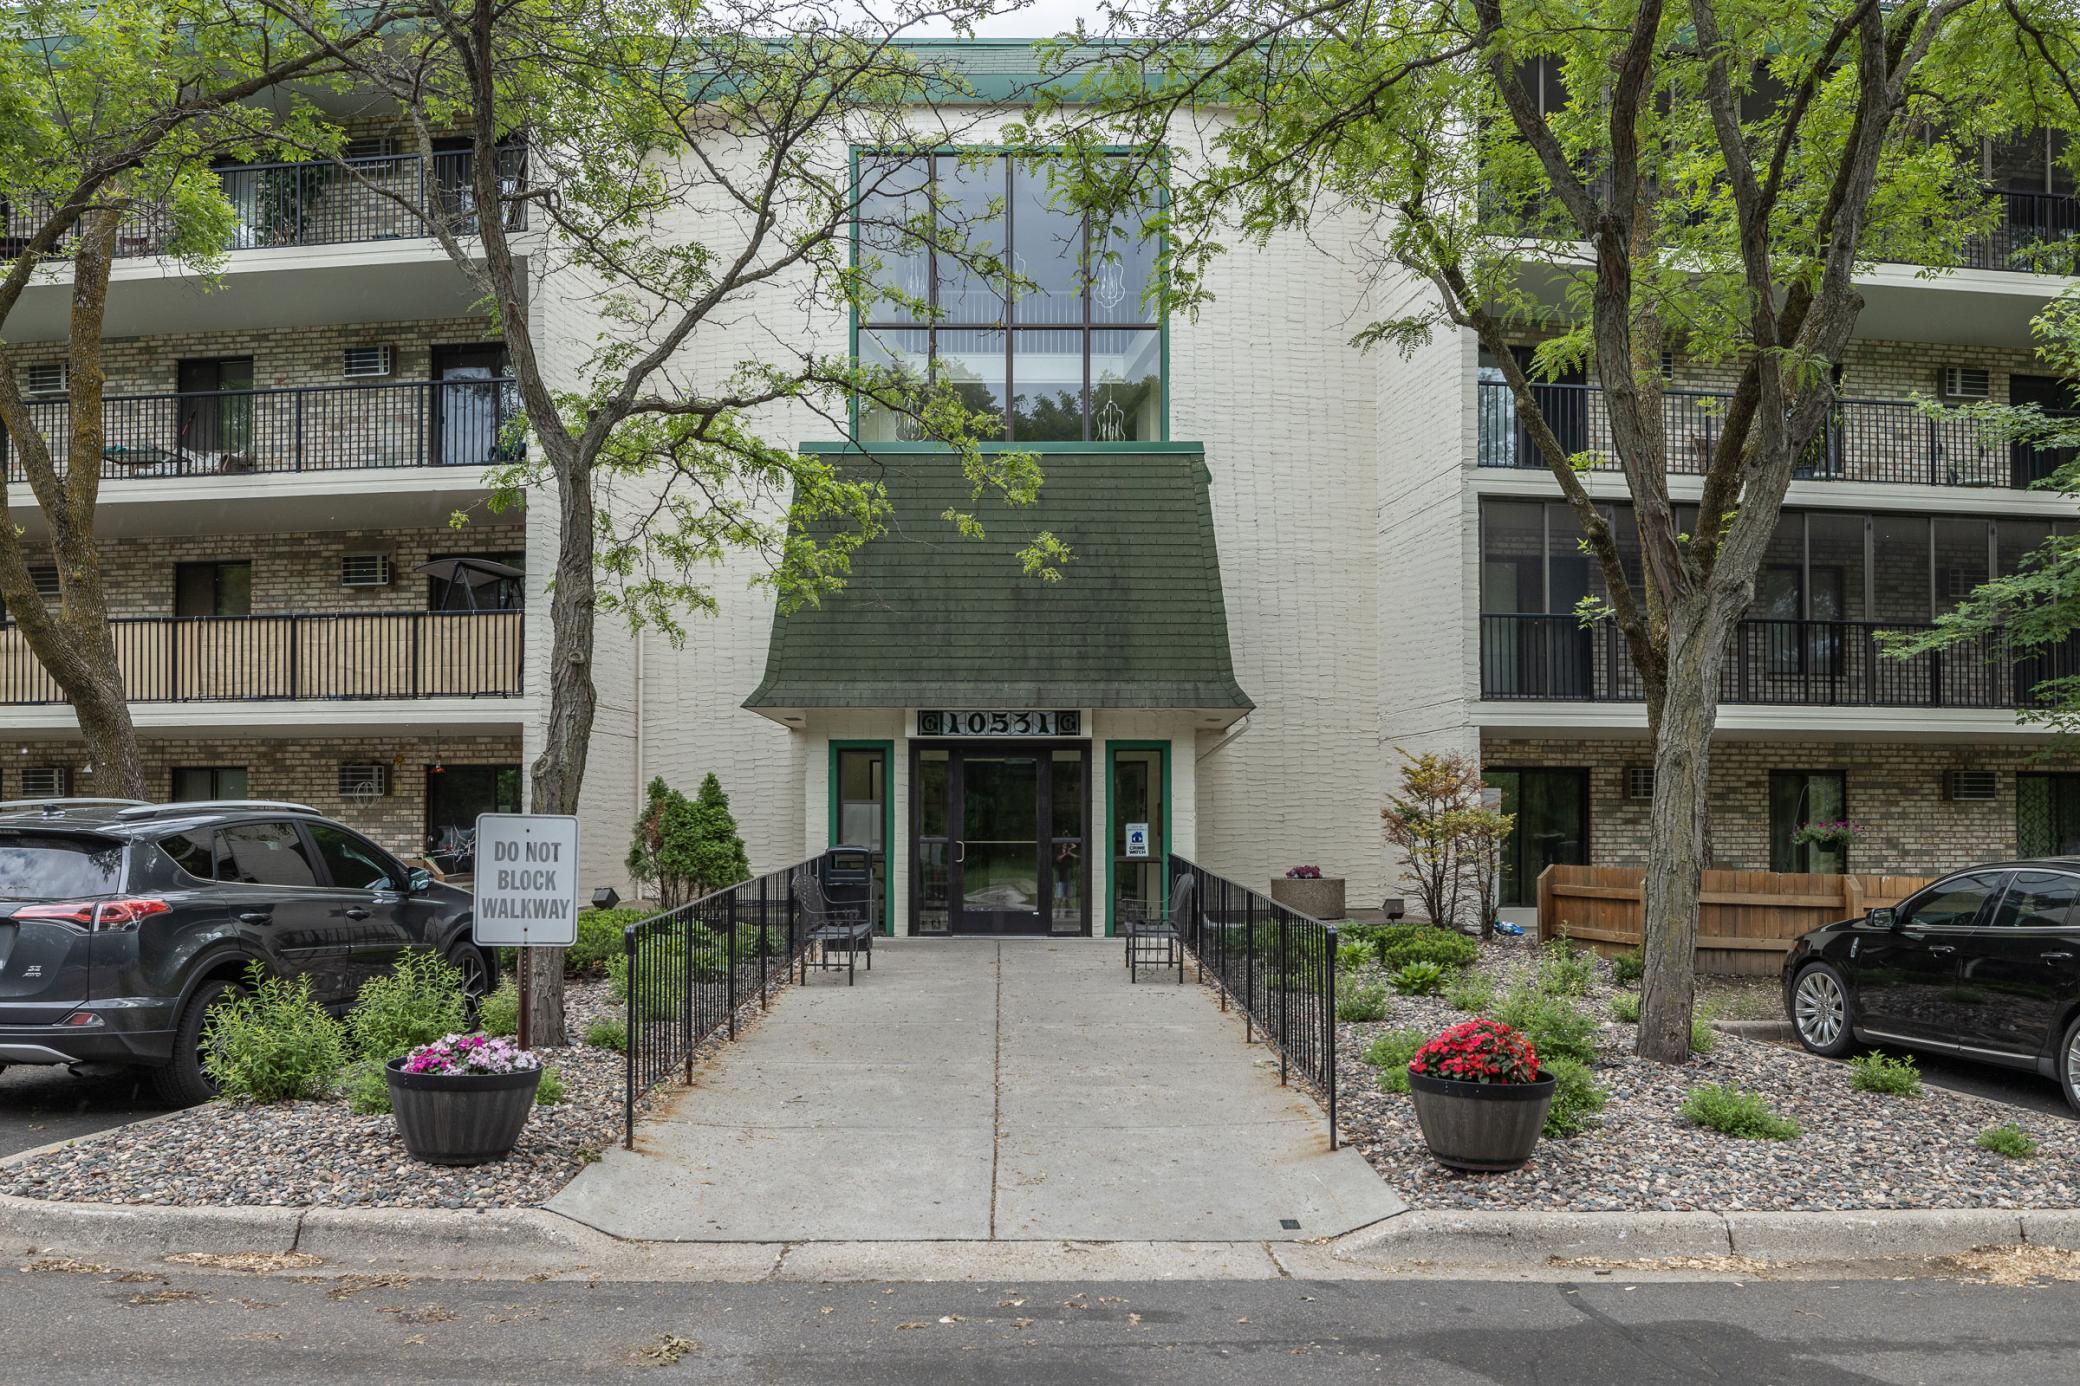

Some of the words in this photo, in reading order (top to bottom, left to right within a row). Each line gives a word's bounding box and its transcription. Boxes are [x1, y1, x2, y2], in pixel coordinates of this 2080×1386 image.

[948, 712, 1051, 734] 10531
[494, 840, 519, 862] DO
[525, 841, 562, 862] NOT
[497, 869, 557, 891] BLOCK
[481, 897, 571, 919] WALKWAY
